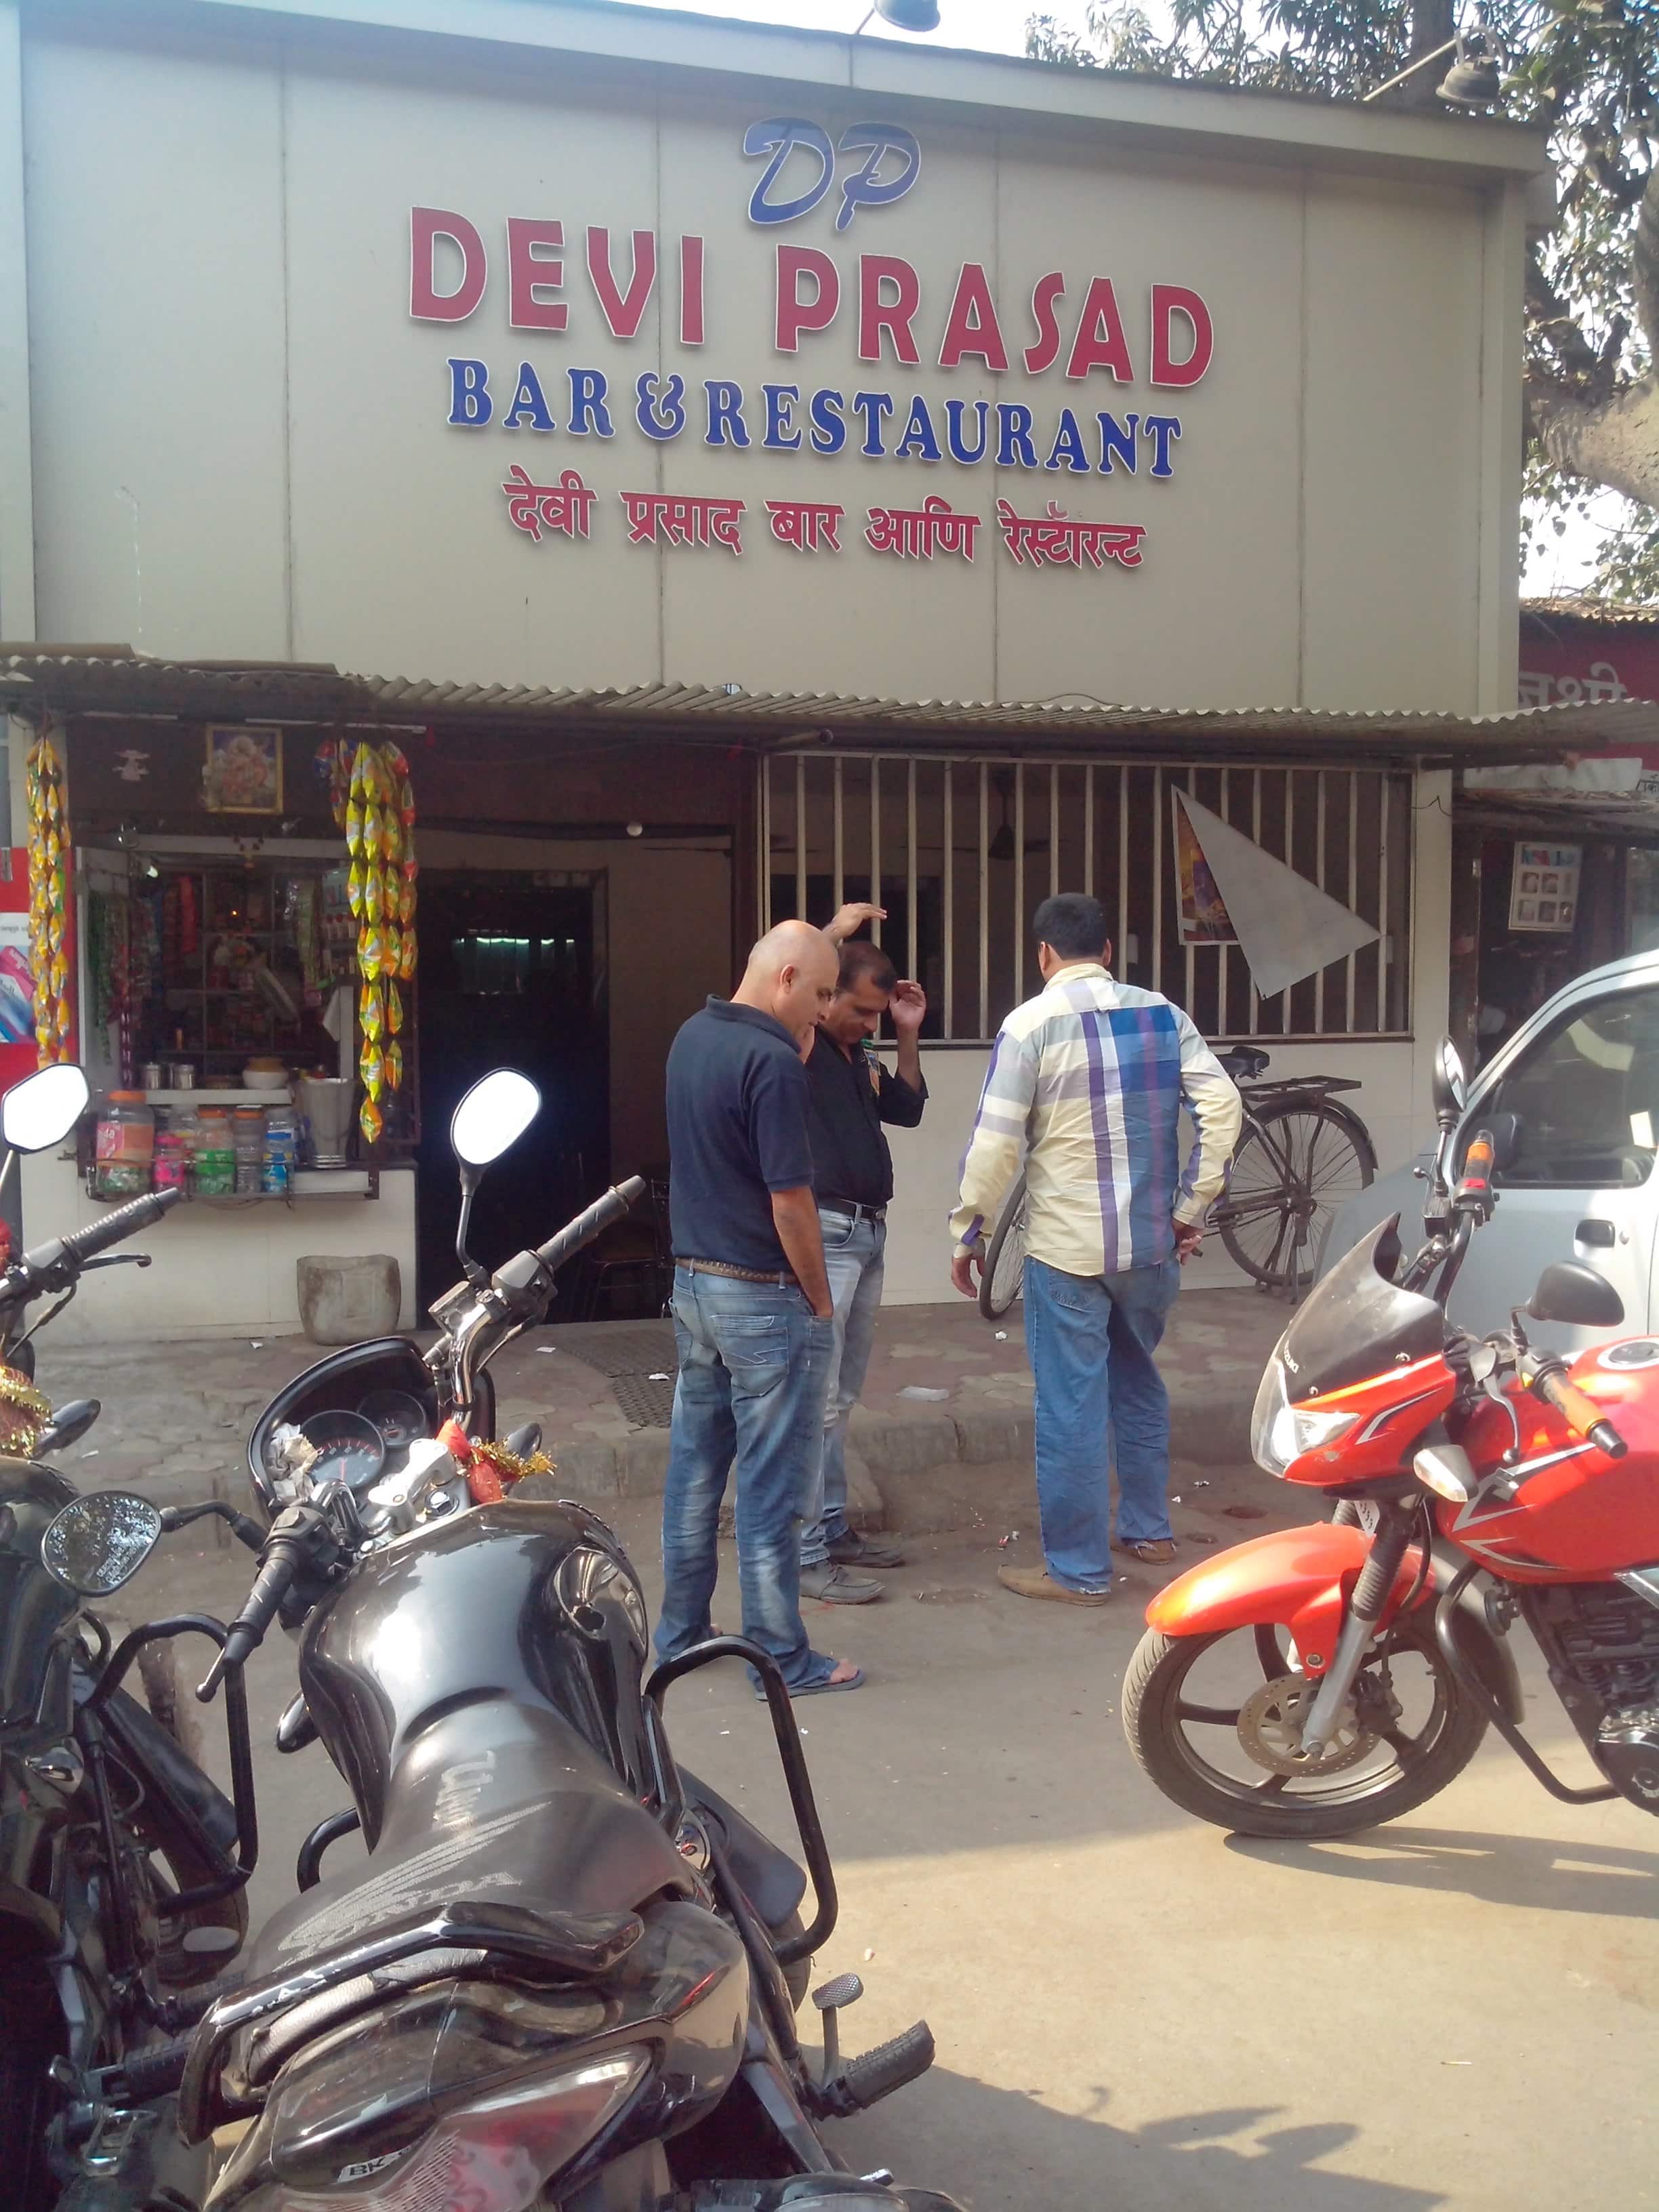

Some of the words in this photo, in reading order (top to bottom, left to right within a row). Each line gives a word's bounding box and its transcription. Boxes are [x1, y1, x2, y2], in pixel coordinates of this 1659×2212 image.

[743, 116, 922, 231] DP
[409, 205, 705, 346] DEVI
[775, 244, 1214, 388] PRASAD
[501, 464, 599, 542] देवी
[618, 490, 747, 556] प्रसाद
[763, 499, 846, 552] बार
[864, 493, 982, 562] आणि
